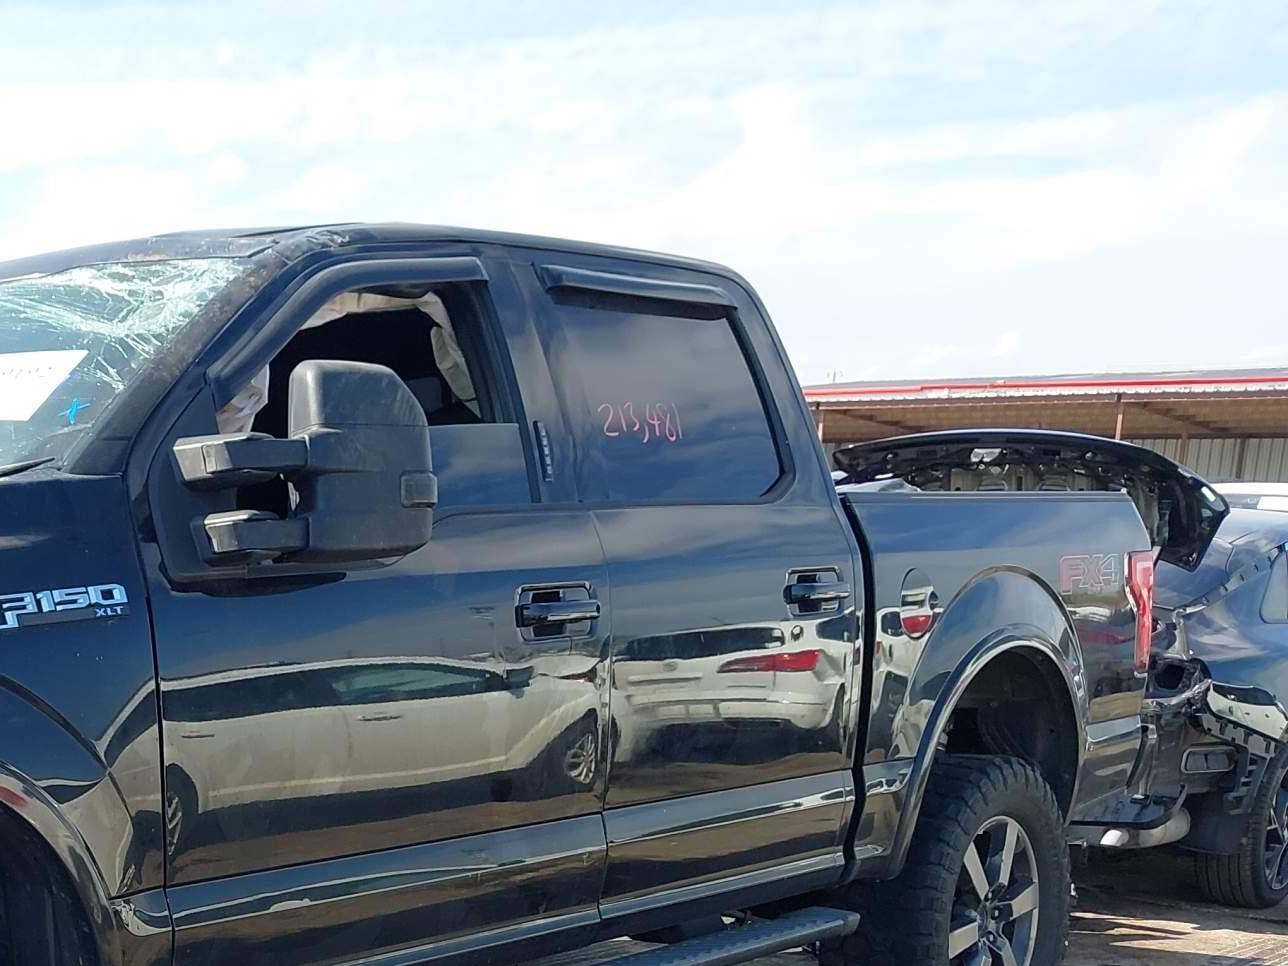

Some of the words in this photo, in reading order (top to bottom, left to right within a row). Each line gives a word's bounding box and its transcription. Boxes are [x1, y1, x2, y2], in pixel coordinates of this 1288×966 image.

[597, 400, 683, 444] 213,481
[1058, 551, 1120, 595] FX4
[94, 604, 125, 617] XLT
